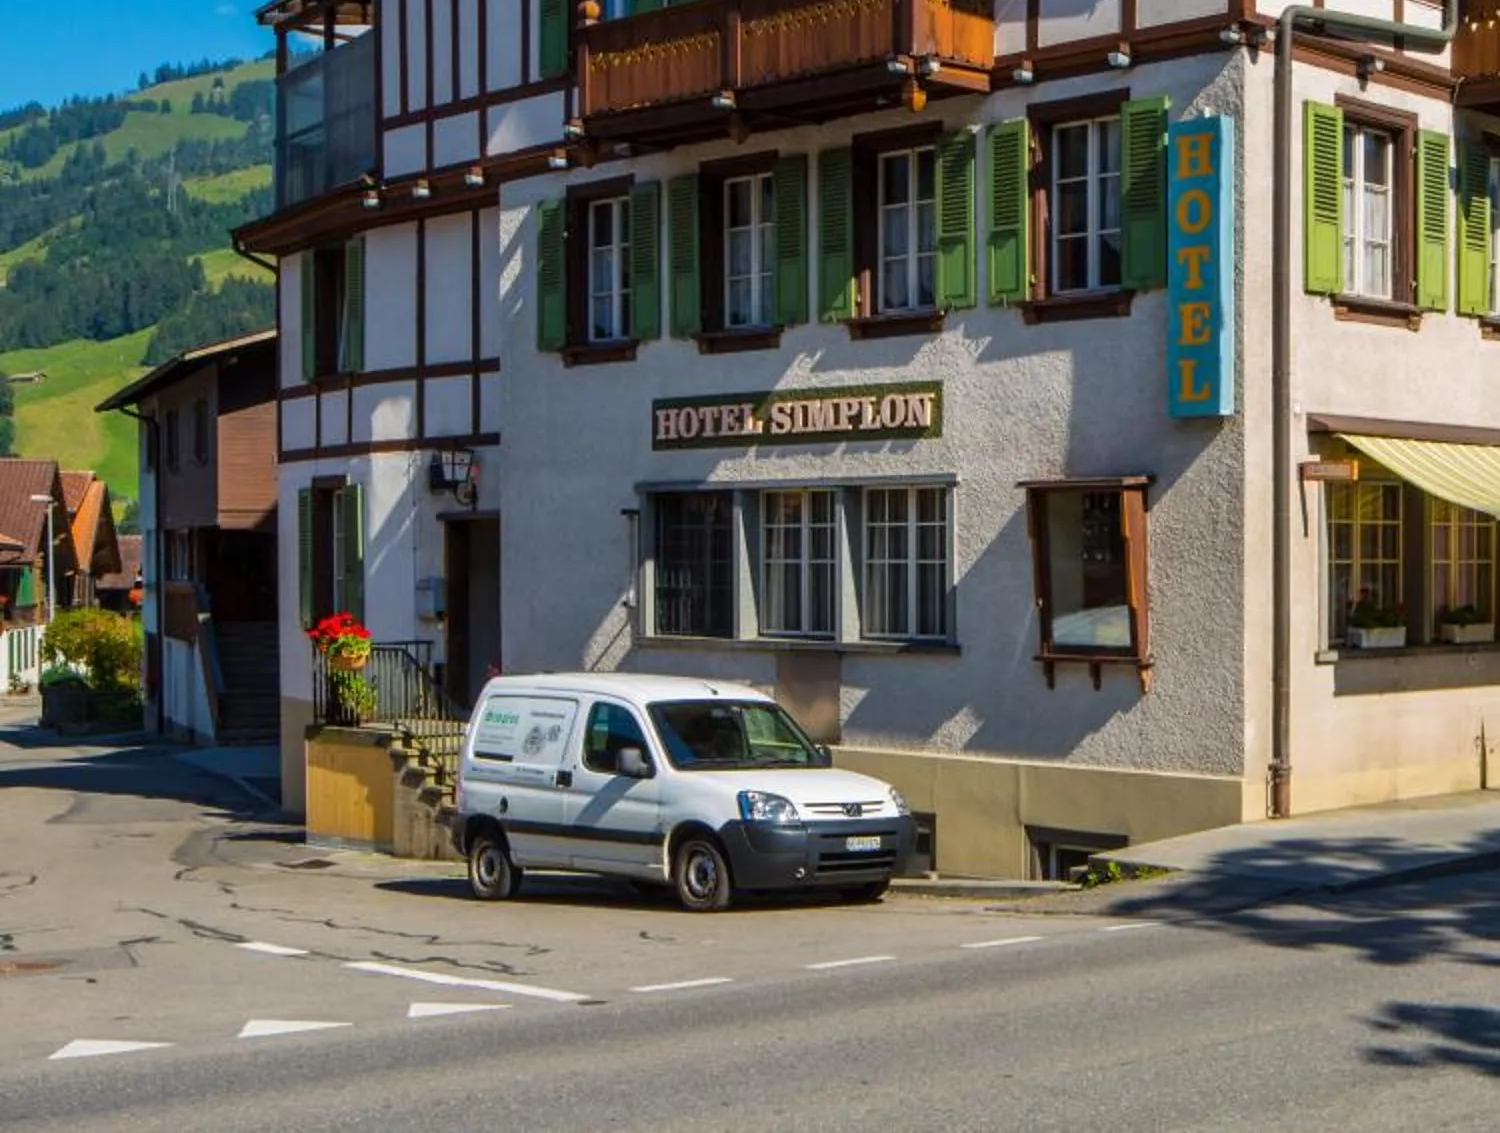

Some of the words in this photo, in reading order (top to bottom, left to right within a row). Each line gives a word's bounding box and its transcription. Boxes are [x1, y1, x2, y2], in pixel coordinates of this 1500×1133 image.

[1176, 132, 1215, 402] HOTEL
[655, 402, 763, 441] HOTEL
[770, 392, 935, 434] SIMPLON
